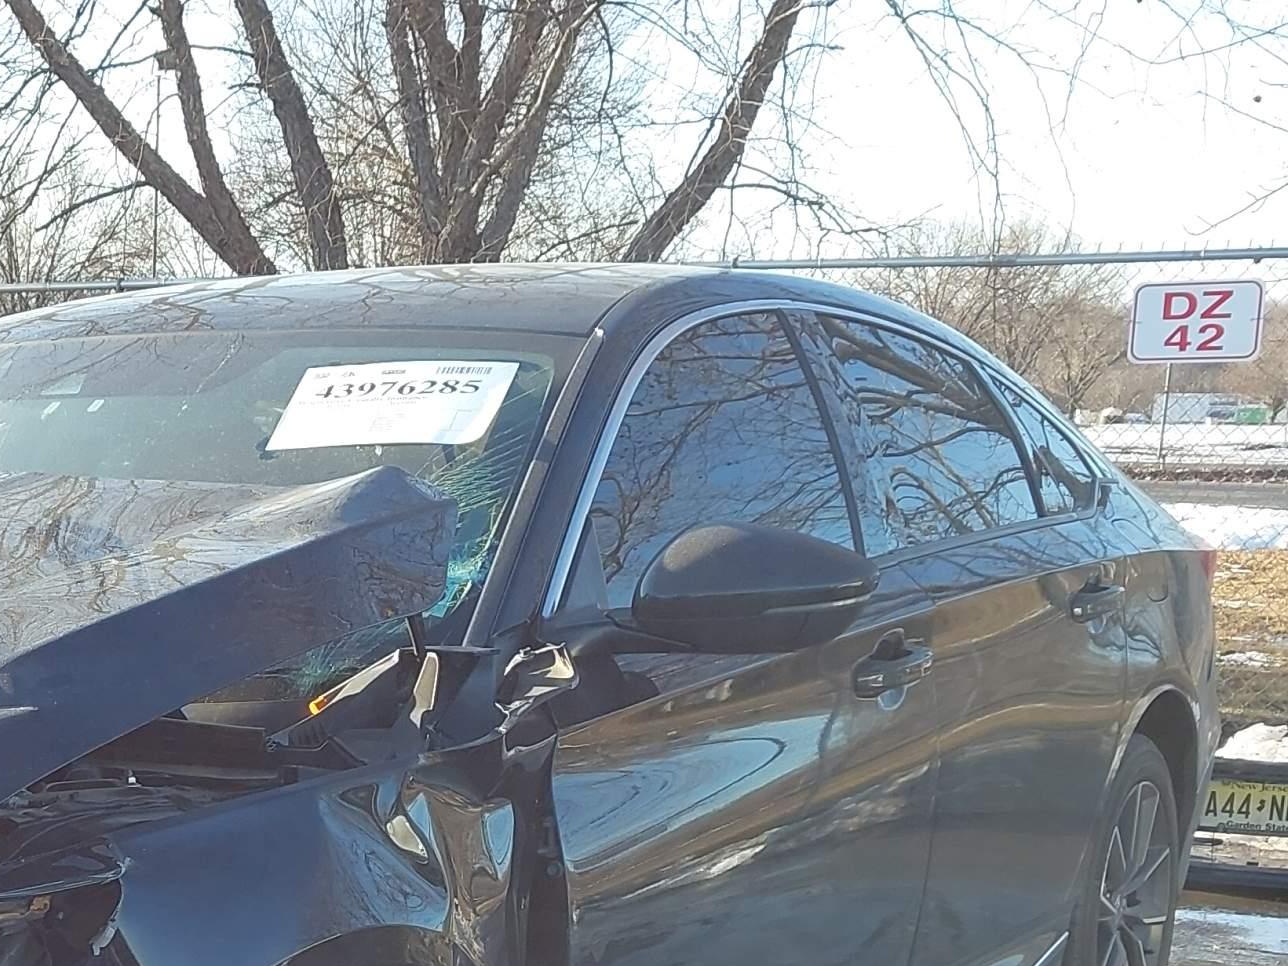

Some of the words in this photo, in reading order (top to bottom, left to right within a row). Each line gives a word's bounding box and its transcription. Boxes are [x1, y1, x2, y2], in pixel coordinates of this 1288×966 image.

[1162, 290, 1234, 320] DZ
[1163, 323, 1225, 352] 42
[315, 379, 483, 399] 43976285
[1269, 794, 1288, 822] N
